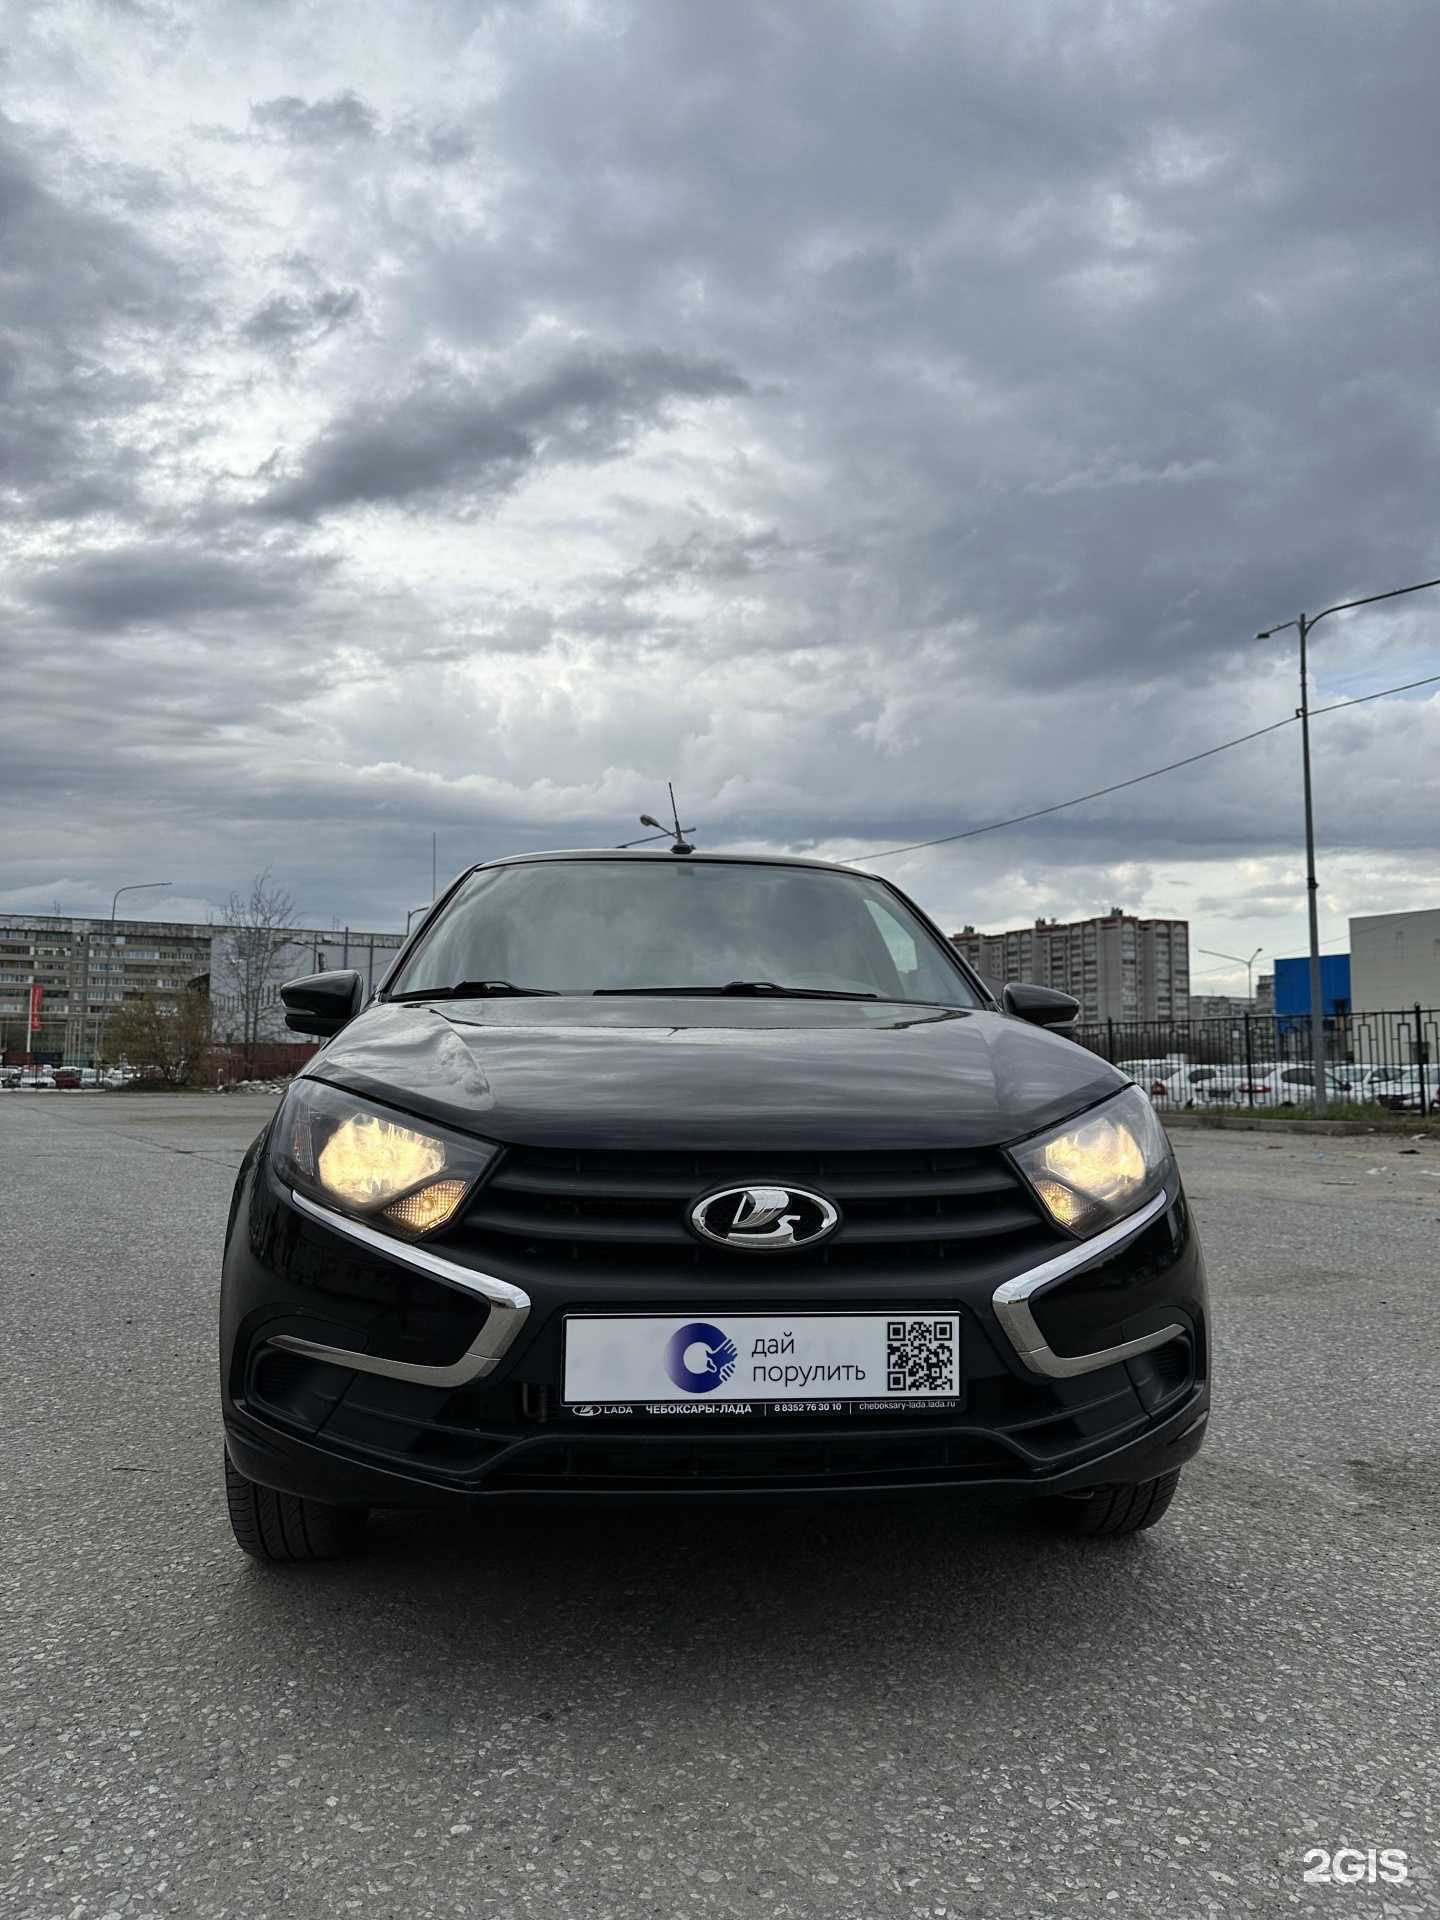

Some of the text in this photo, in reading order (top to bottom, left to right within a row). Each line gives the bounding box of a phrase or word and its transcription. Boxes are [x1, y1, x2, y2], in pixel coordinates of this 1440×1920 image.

[751, 1331, 795, 1358] дай
[753, 1365, 866, 1387] порулить
[604, 1406, 633, 1415] LADA
[646, 1404, 752, 1414] ЧЕБОКСАРЫ-ЛАДА
[774, 1404, 781, 1412] 8
[782, 1403, 804, 1412] 8352
[832, 1402, 842, 1411] 10
